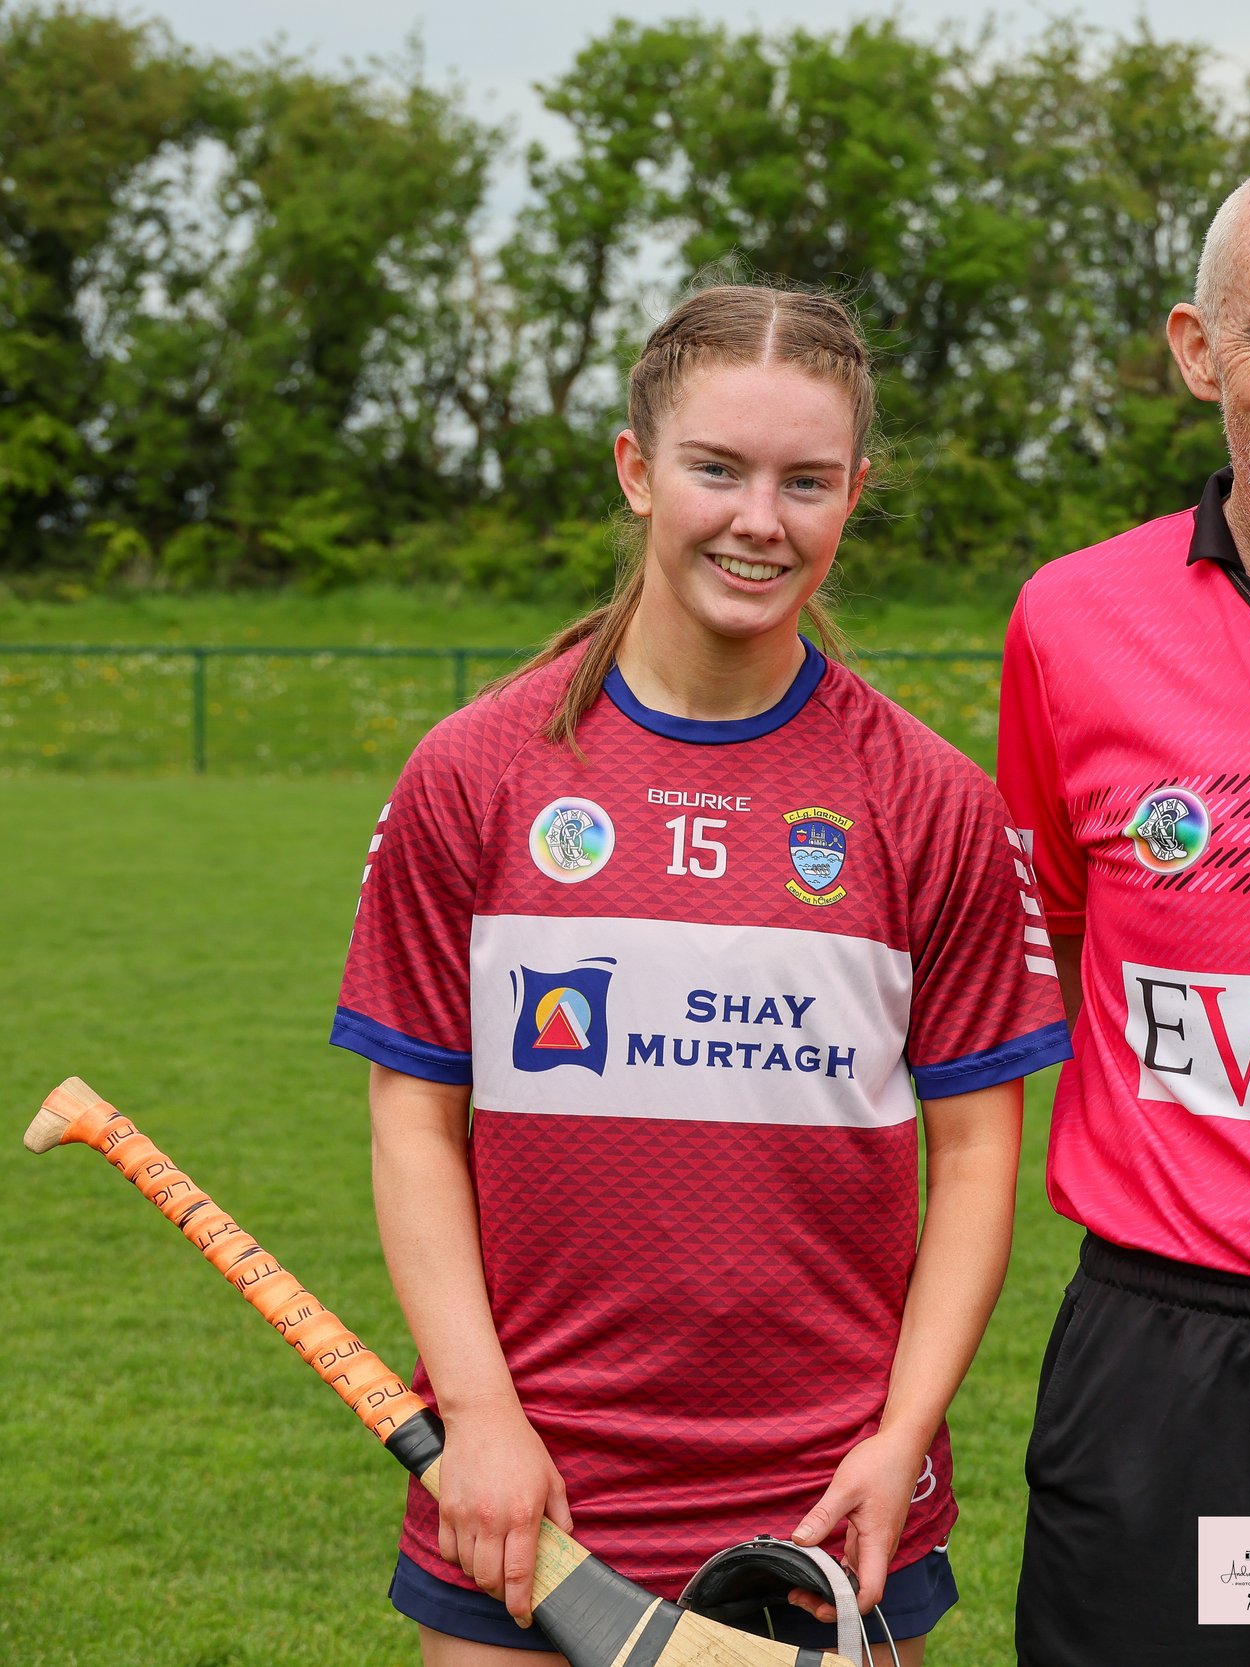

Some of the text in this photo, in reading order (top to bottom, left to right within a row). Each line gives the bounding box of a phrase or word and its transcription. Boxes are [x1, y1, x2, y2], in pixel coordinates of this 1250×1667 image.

[648, 788, 752, 812] BOURKE
[665, 814, 727, 879] 15
[685, 989, 817, 1029] SHAY
[626, 1033, 856, 1079] MURTAGH
